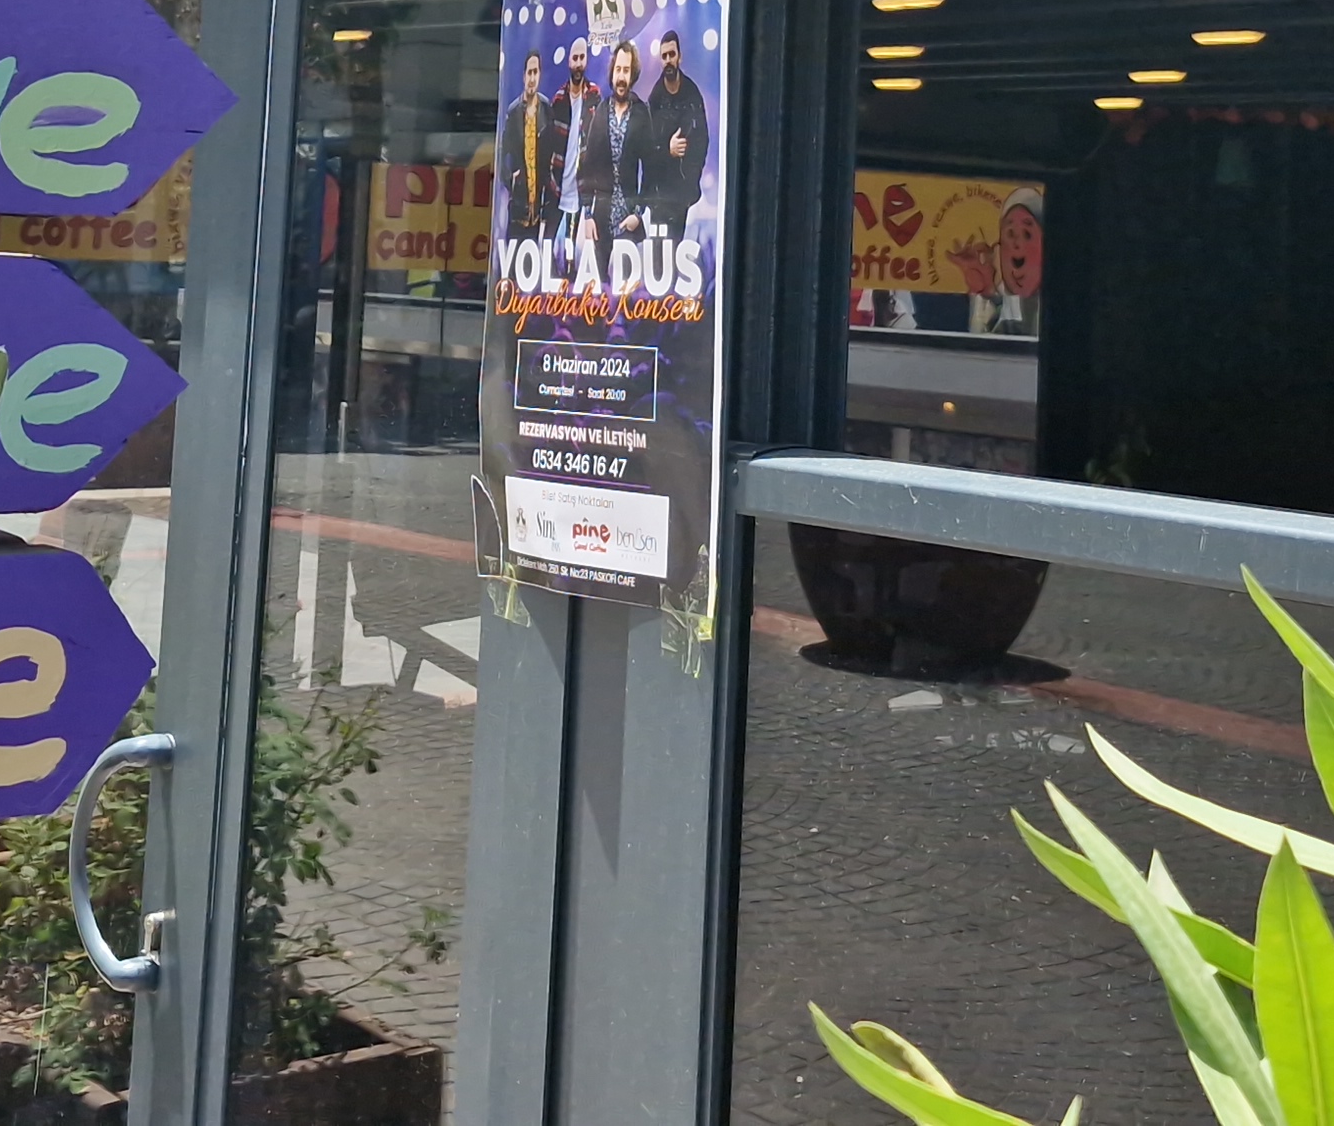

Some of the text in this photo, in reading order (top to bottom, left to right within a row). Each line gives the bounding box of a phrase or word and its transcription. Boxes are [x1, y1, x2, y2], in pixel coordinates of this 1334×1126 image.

[495, 278, 705, 334] Diyarbakır Konseri
[542, 353, 631, 377] 8 Haziran 2024
[587, 387, 605, 400] Saat
[518, 421, 647, 452] REZERVASYON VE İLETİŞİM
[532, 448, 628, 478] 0534 346 16 47
[617, 574, 636, 587] CAFE
